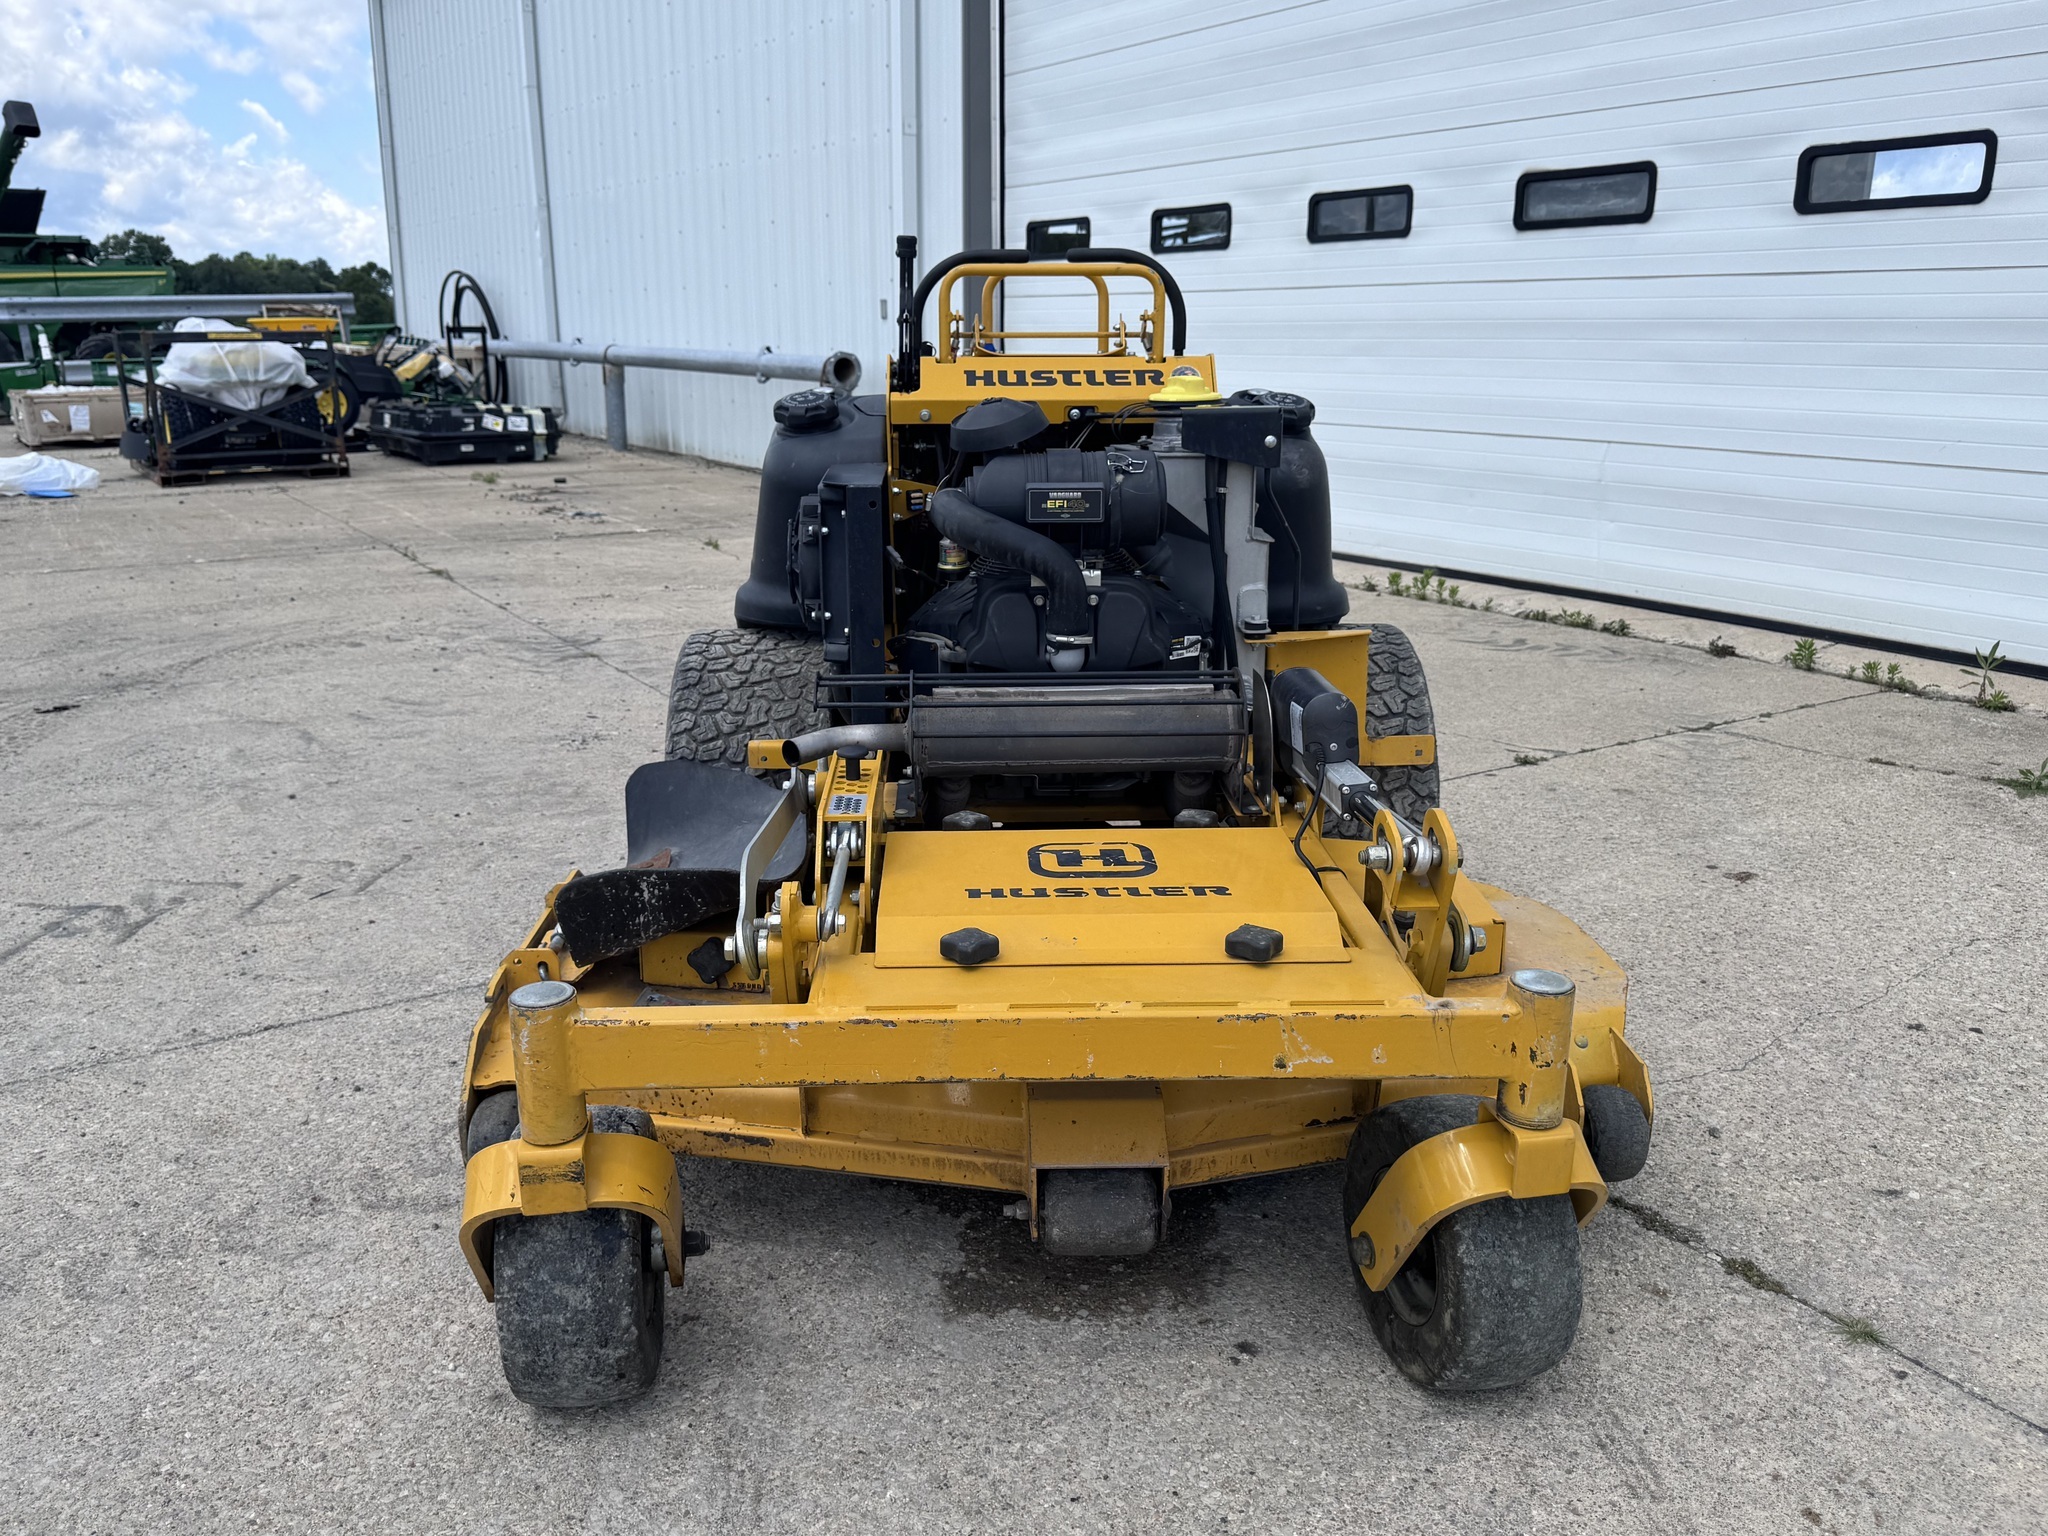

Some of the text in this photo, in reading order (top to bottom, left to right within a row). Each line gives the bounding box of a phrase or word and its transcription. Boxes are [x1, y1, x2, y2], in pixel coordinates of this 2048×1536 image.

[964, 370, 1164, 386] HUSTLER
[1049, 491, 1082, 499] VANGUARD
[965, 886, 1232, 898] HUSTLER
